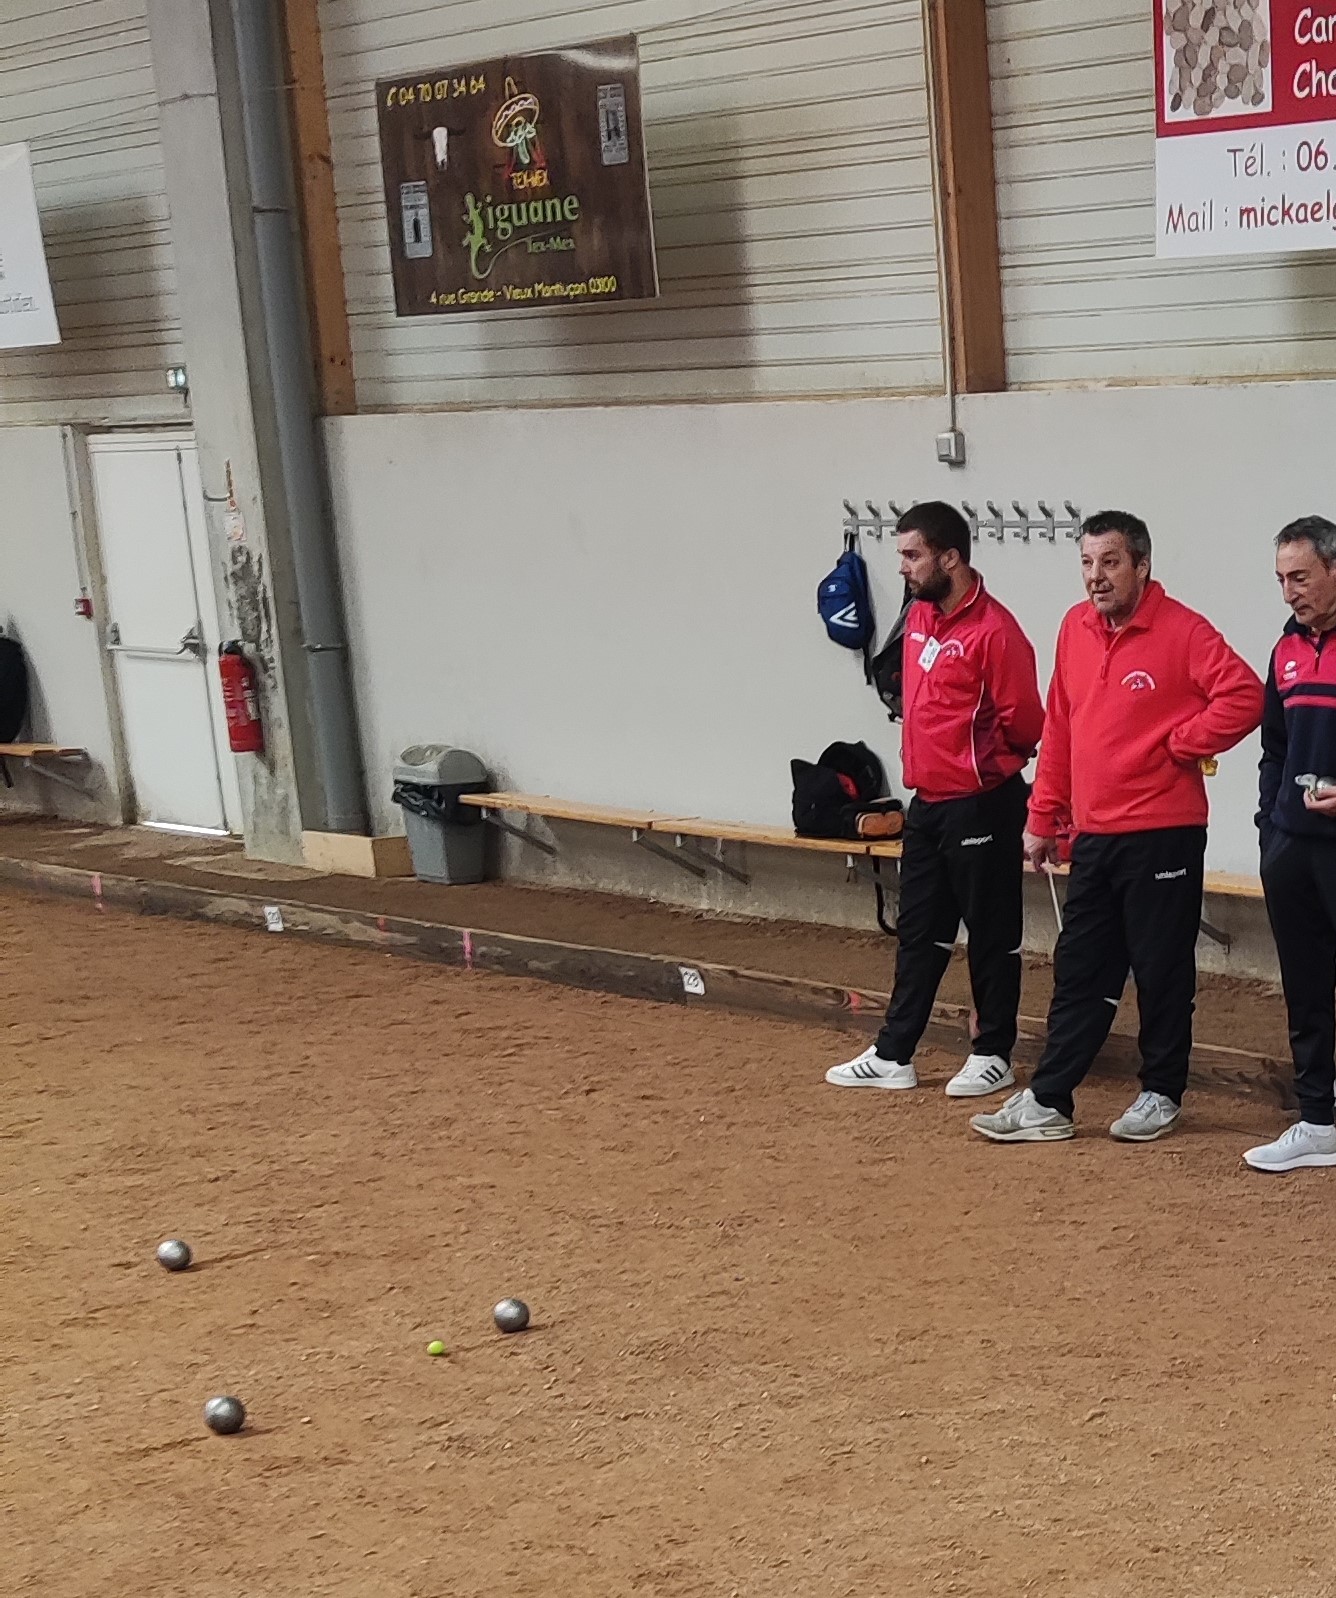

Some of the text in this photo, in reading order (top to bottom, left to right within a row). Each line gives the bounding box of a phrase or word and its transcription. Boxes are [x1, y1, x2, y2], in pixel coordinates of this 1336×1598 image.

[399, 86, 415, 105] 04
[1227, 143, 1271, 177] Tél.
[1165, 199, 1214, 234] Mail
